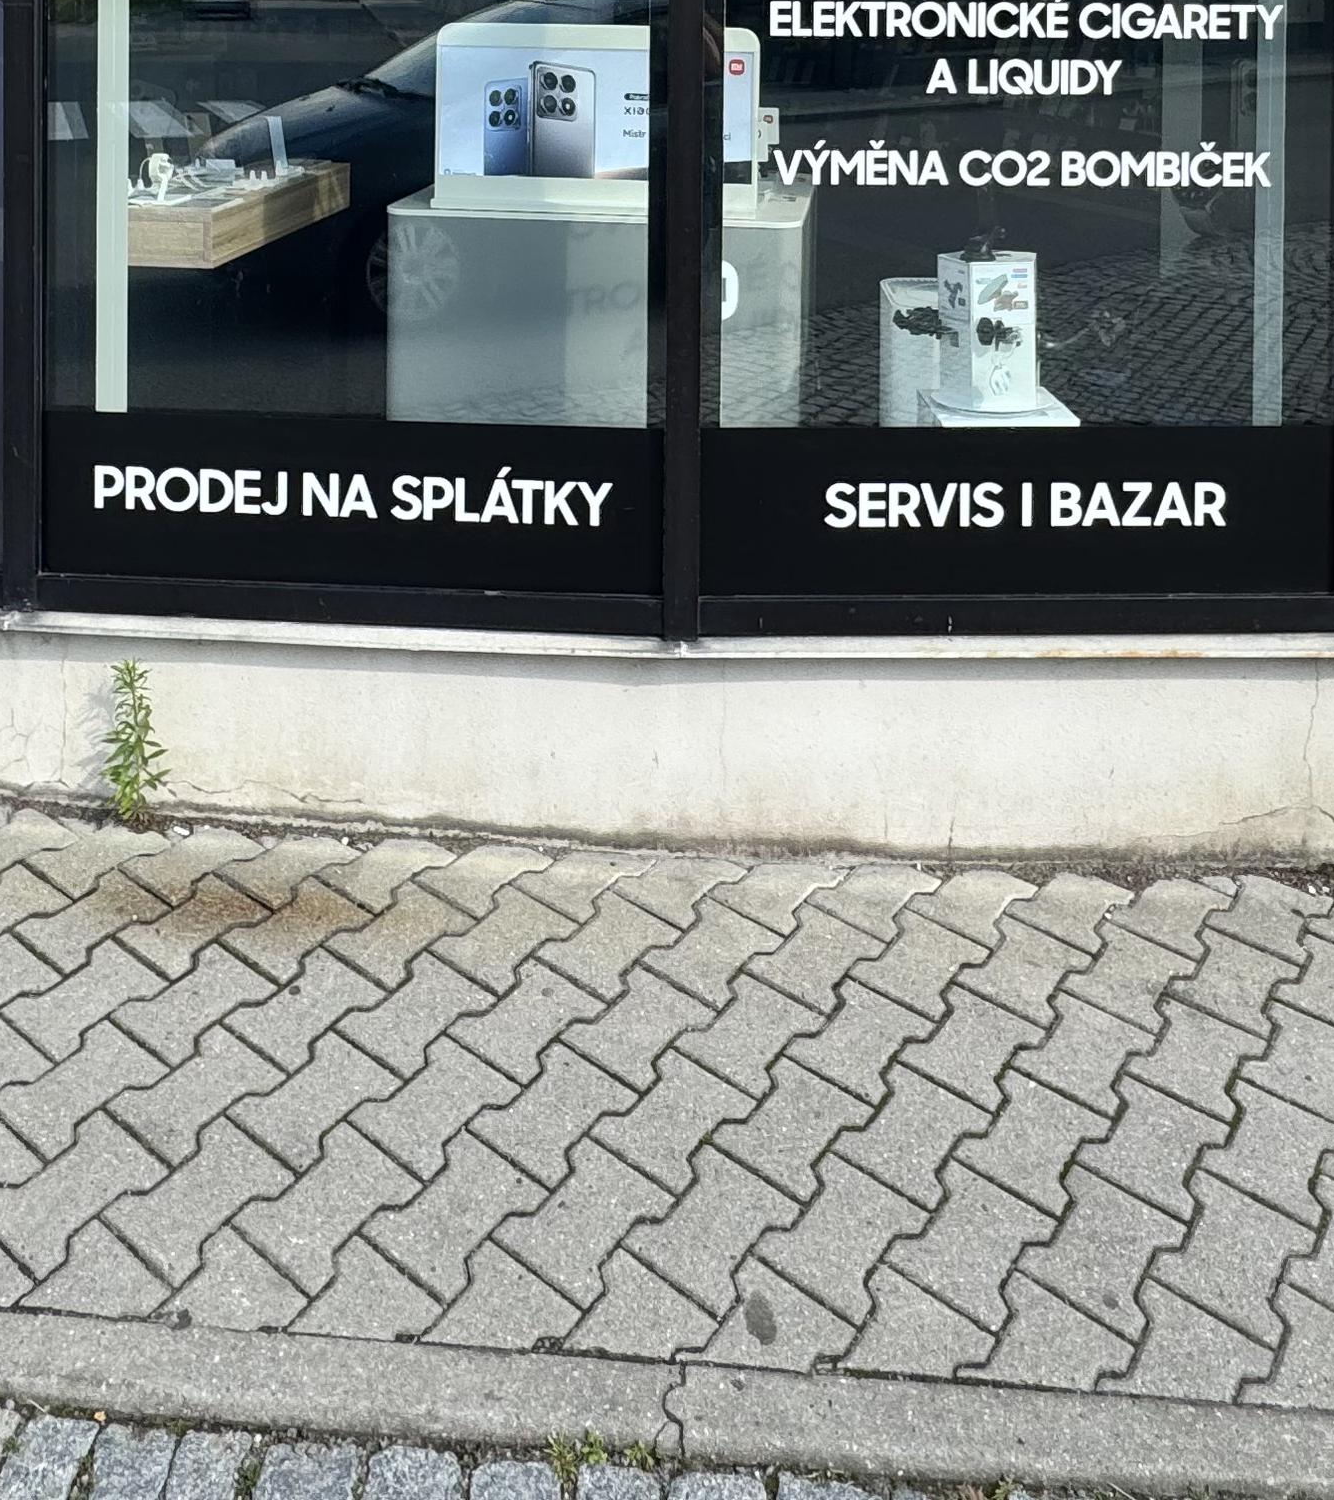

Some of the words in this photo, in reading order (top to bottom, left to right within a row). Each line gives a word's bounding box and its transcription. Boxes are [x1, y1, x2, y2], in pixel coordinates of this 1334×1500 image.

[1078, 1, 1284, 42] CIGARETY
[925, 58, 958, 96] A
[967, 58, 1123, 98] LIQUIDY
[773, 139, 949, 187] VÝMĚNA
[959, 150, 1051, 188] CO2
[1060, 140, 1272, 189] BOMBIČEK
[92, 463, 289, 518] PRODEJ
[301, 472, 377, 521] NA
[389, 465, 614, 528] SPLÁTKY
[822, 481, 1005, 529] SERVIS
[1020, 482, 1033, 528] I
[1049, 481, 1227, 529] BAZAR
